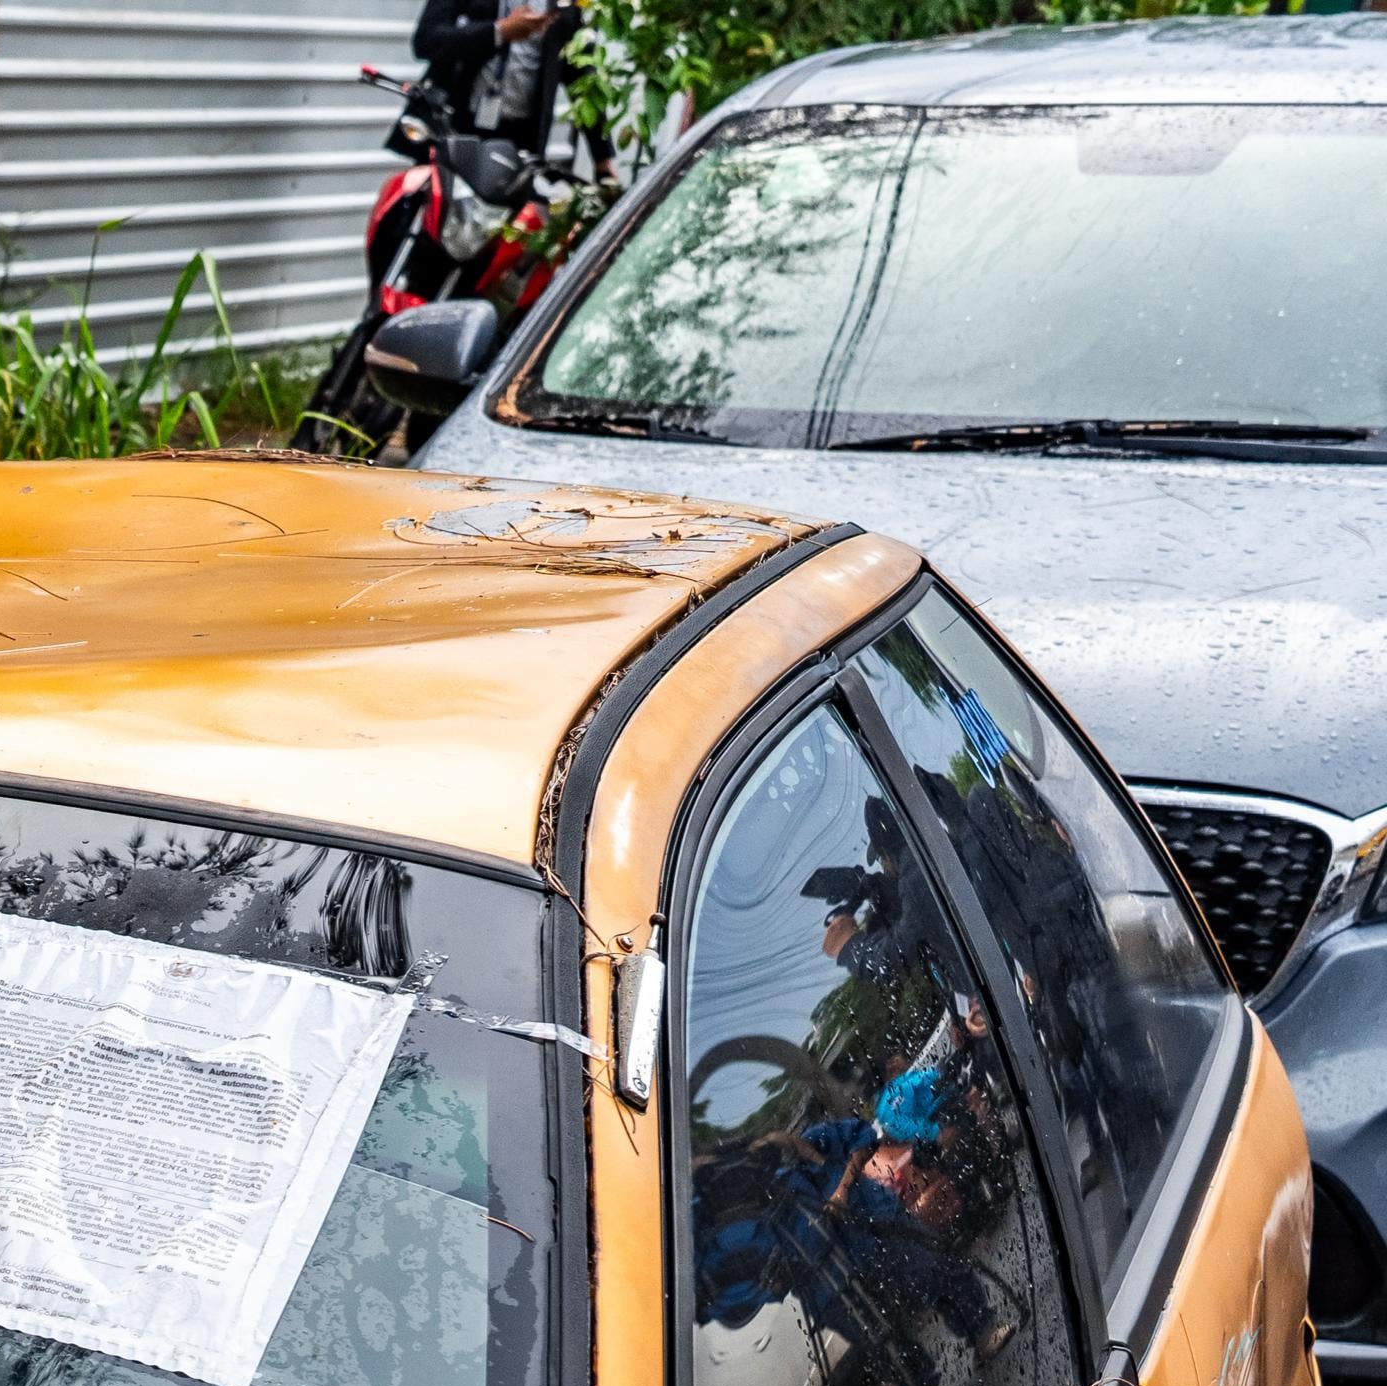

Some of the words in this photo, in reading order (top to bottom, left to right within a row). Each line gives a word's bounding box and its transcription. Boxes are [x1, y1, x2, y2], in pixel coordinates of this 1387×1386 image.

[140, 1016, 195, 1032] Abandonado
[88, 1050, 130, 1066] cualquier
[221, 1080, 268, 1090] automotor
[207, 1067, 268, 1082] Automotores
[86, 1073, 139, 1088] sancionado
[182, 1093, 210, 1104] multa
[157, 1117, 188, 1128] mayor
[176, 1114, 225, 1128] automotor
[142, 1158, 190, 1173] SETENTA
[78, 1220, 136, 1238] conformidad
[12, 1270, 84, 1294] Contravencional
[20, 1281, 60, 1295] Salvador
